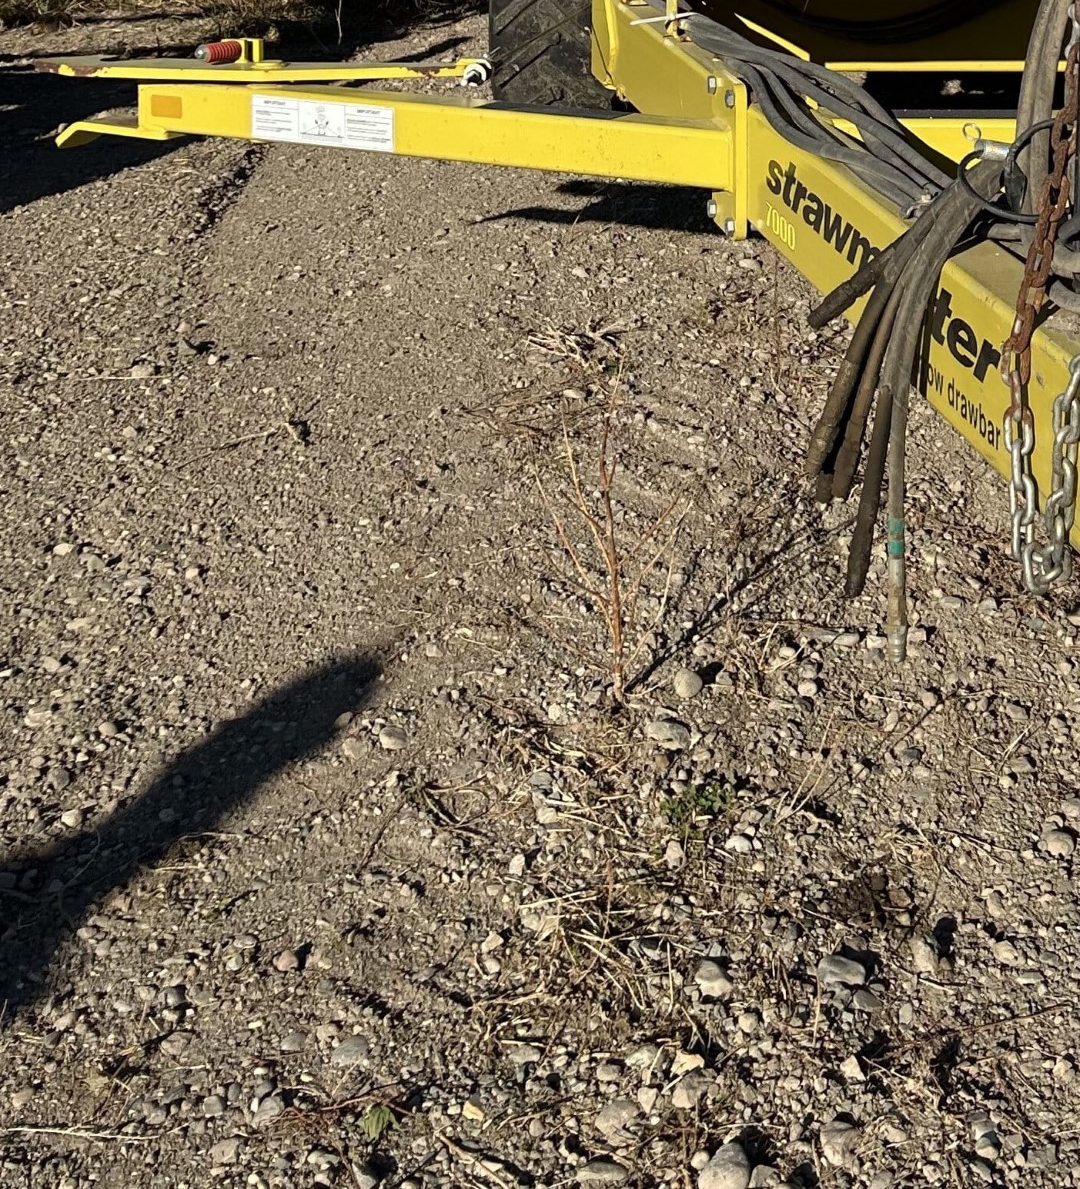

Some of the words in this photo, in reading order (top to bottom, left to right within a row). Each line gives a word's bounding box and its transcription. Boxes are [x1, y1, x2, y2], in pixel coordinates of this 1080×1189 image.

[766, 201, 796, 250] 7000
[766, 160, 1001, 383] strawmter
[926, 363, 944, 395] ow
[948, 377, 1001, 451] drawbar
